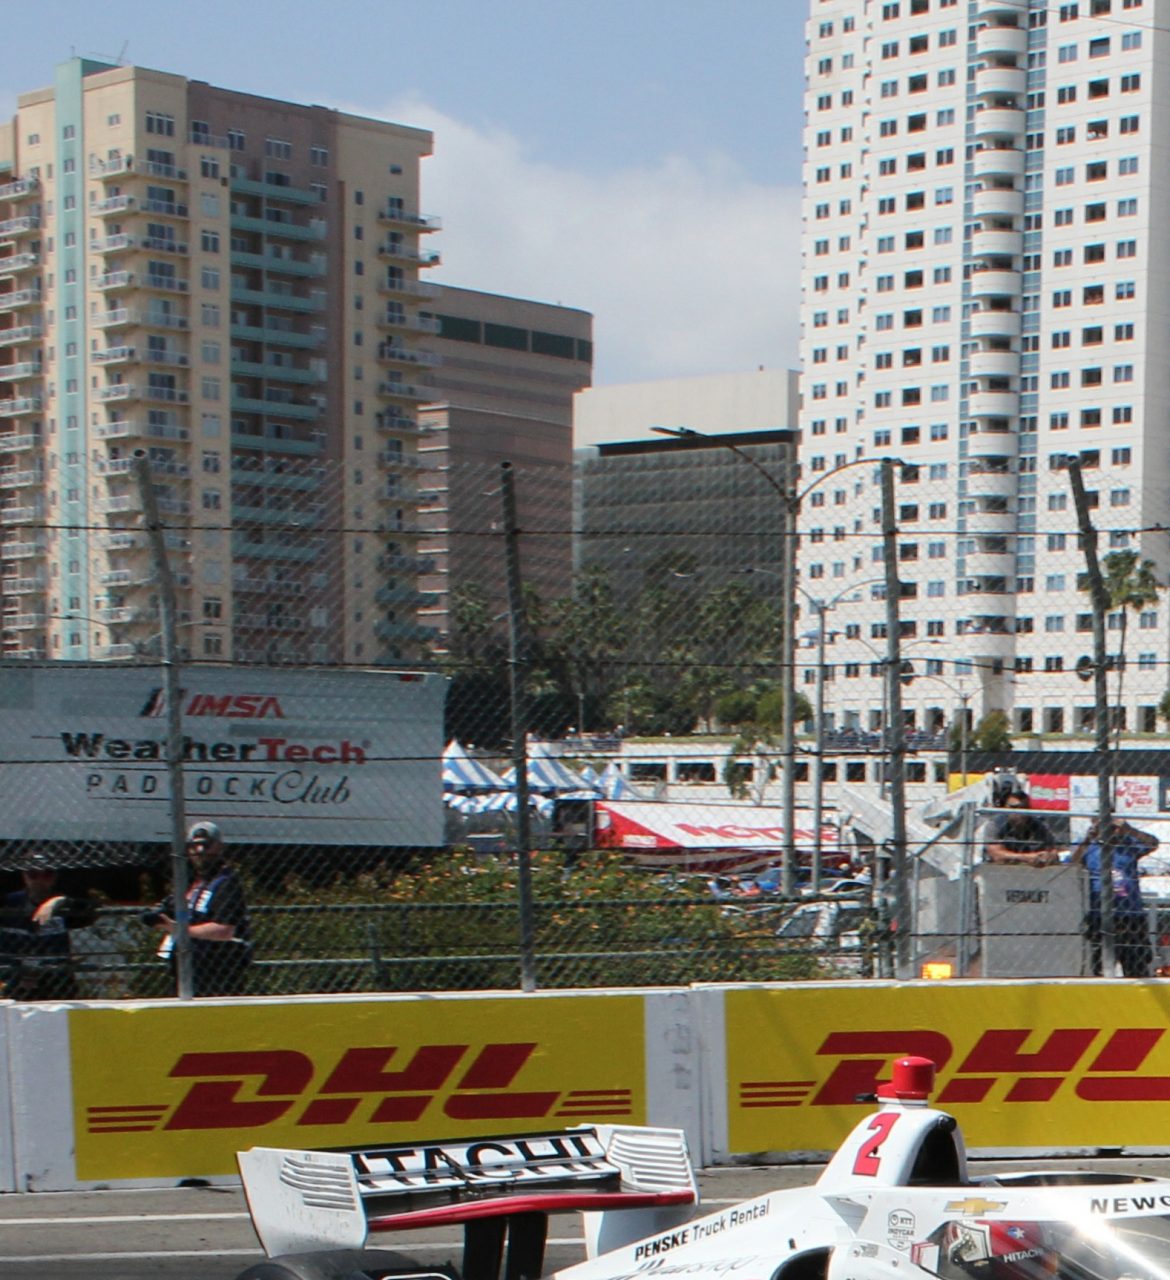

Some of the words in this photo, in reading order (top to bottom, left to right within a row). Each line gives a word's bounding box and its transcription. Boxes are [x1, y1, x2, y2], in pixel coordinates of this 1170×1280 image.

[186, 693, 286, 718] IMSA
[61, 732, 366, 765] WeaherTech
[87, 773, 267, 796] PADOCK
[272, 769, 350, 804] Club
[164, 1043, 559, 1130] DHL
[350, 1135, 598, 1190] ITACHI
[852, 1112, 901, 1177] 2
[635, 1230, 689, 1261] PENSKE
[693, 1215, 726, 1240] Truck
[730, 1199, 770, 1228] Rental
